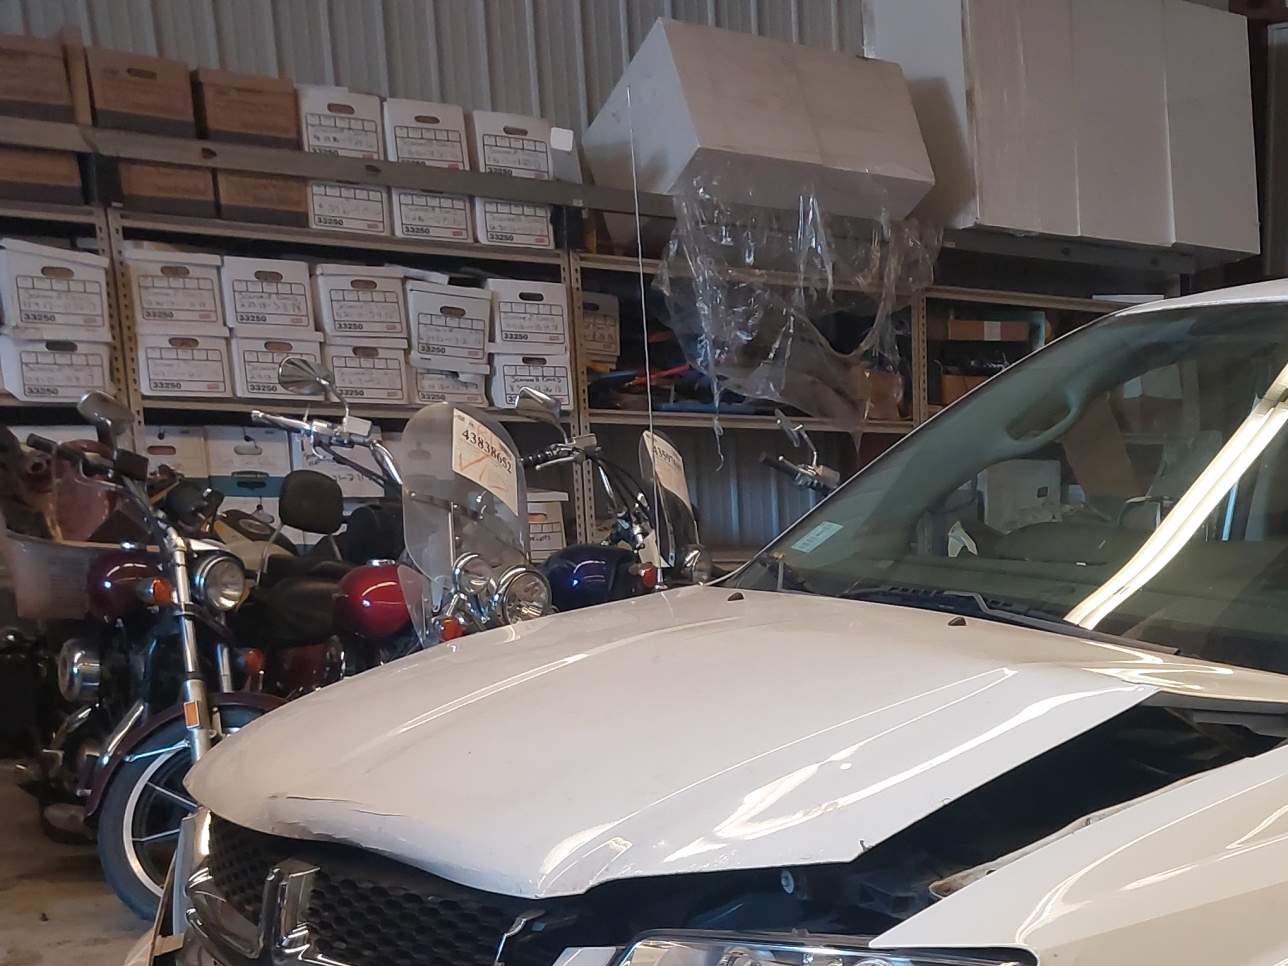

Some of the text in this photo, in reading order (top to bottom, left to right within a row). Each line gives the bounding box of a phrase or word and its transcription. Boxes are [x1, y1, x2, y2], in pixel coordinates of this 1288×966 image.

[317, 216, 344, 226] 33250
[404, 226, 431, 235] 33250
[489, 233, 514, 241] 33250
[24, 313, 56, 322] 33250
[239, 314, 267, 322] 33250
[337, 323, 363, 331] 33250
[504, 333, 529, 341] 33250
[153, 381, 182, 390] 33250
[249, 384, 278, 393] 33250
[462, 429, 512, 474] 43838652
